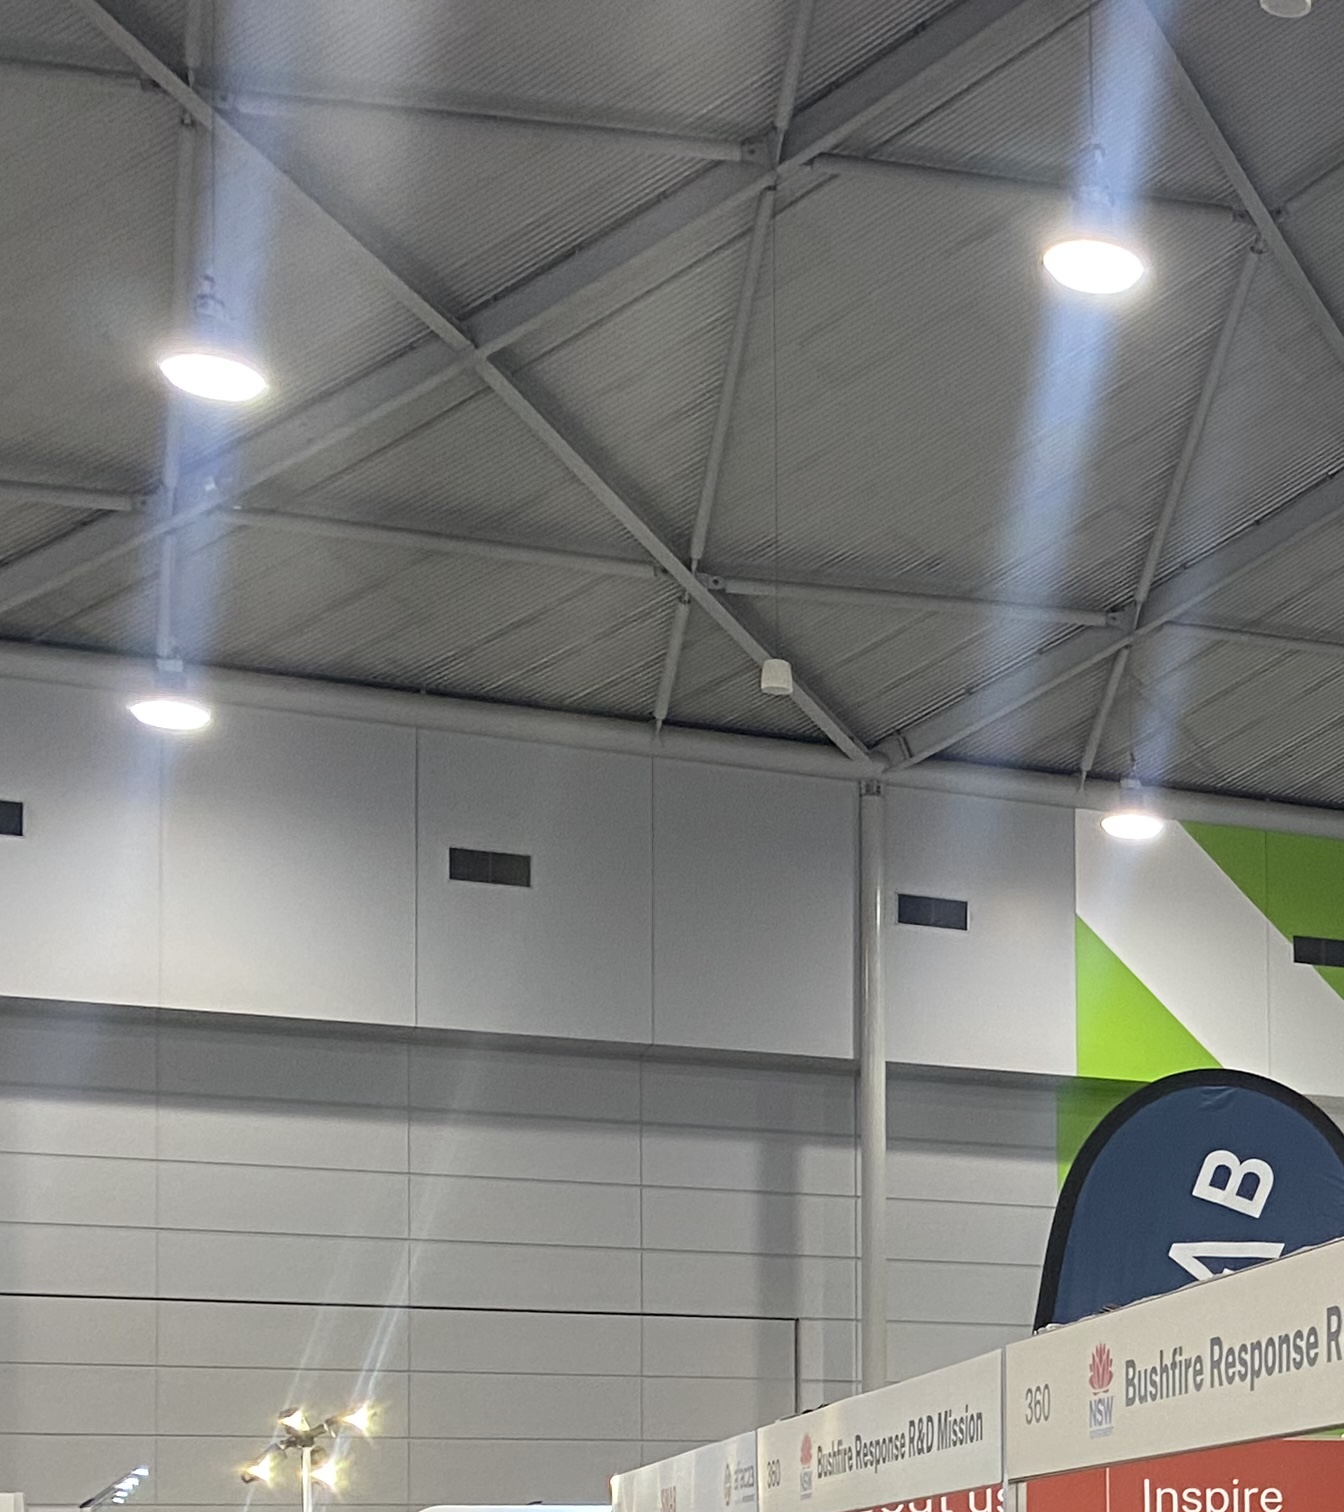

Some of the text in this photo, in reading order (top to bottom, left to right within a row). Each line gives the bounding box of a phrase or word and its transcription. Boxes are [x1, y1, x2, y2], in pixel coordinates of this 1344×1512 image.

[1124, 1346, 1205, 1408] Bushfire
[1209, 1324, 1320, 1391] Response
[1024, 1383, 1051, 1426] 360
[1088, 1396, 1114, 1426] NSW
[816, 1404, 984, 1479] Bushfire Response R&D Mission
